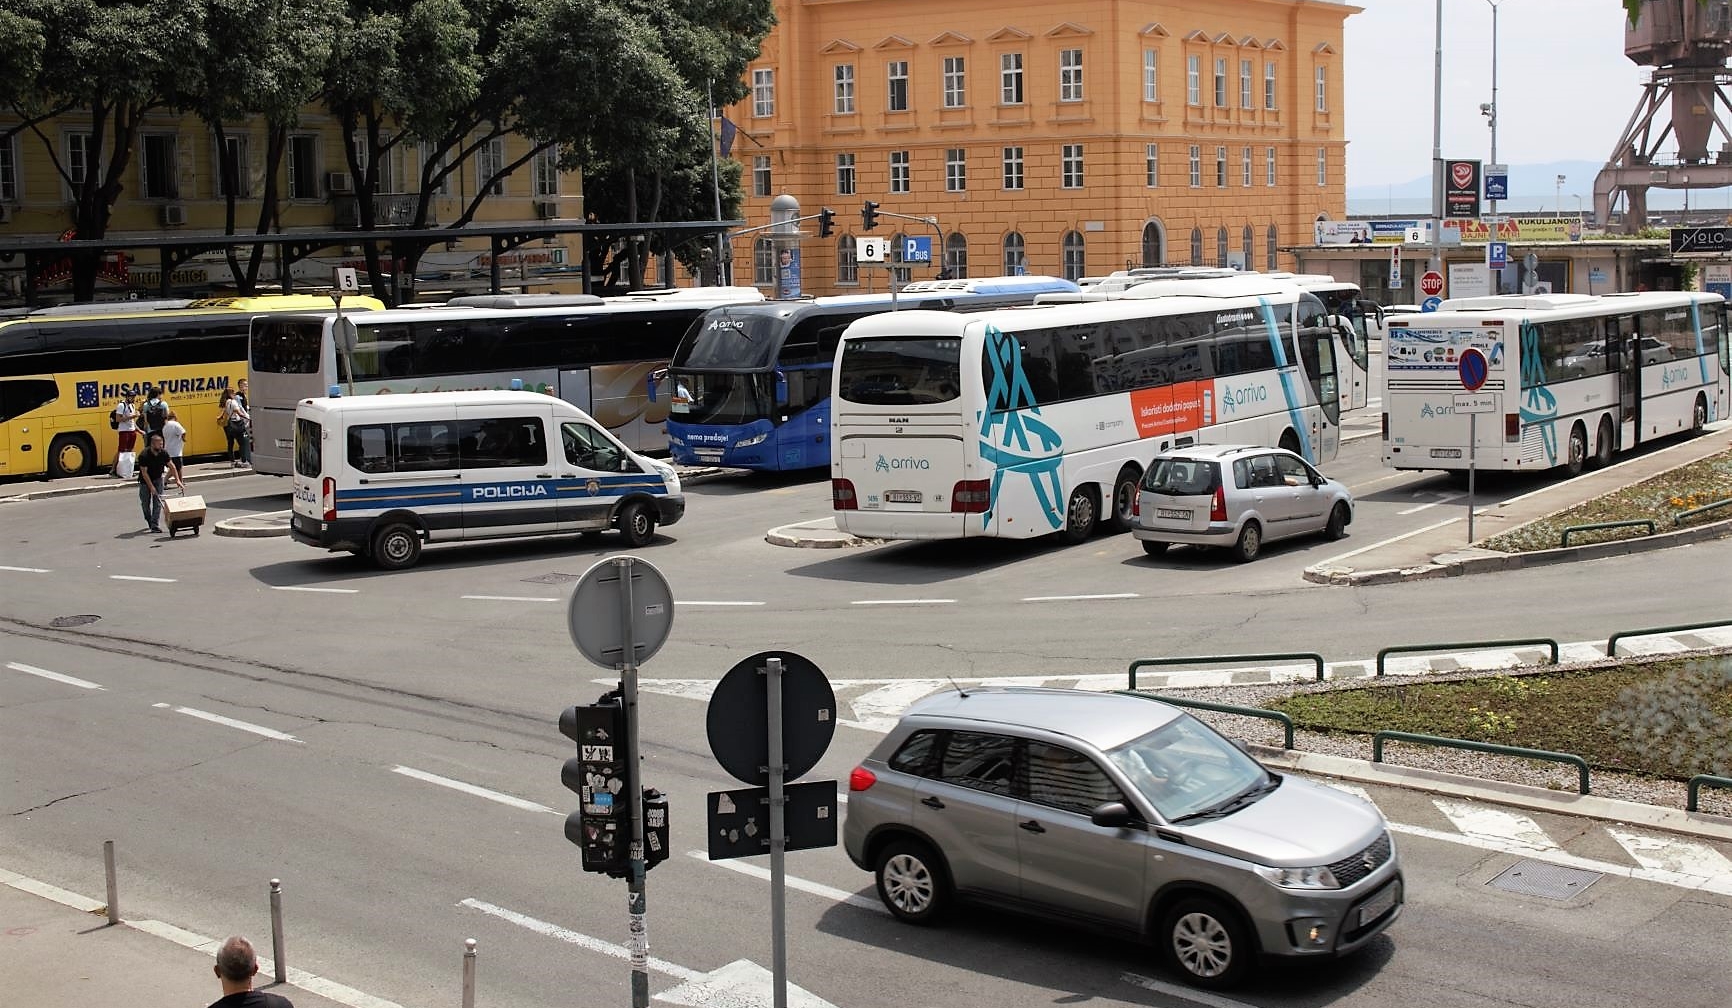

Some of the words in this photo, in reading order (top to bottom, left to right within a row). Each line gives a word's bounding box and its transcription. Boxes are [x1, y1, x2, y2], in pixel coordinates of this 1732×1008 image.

[1412, 233, 1418, 241] 6
[1682, 233, 1724, 243] MOLO
[866, 245, 874, 257] 6
[908, 240, 917, 260] P
[915, 251, 928, 260] BUS
[346, 276, 353, 288] 5
[1422, 279, 1441, 289] STOP
[102, 382, 152, 398] HISAR
[158, 376, 229, 393] TURIZAM
[1236, 383, 1267, 405] arriva
[687, 433, 703, 441] nema
[891, 456, 930, 470] arriva
[472, 485, 548, 499] POLICIJA
